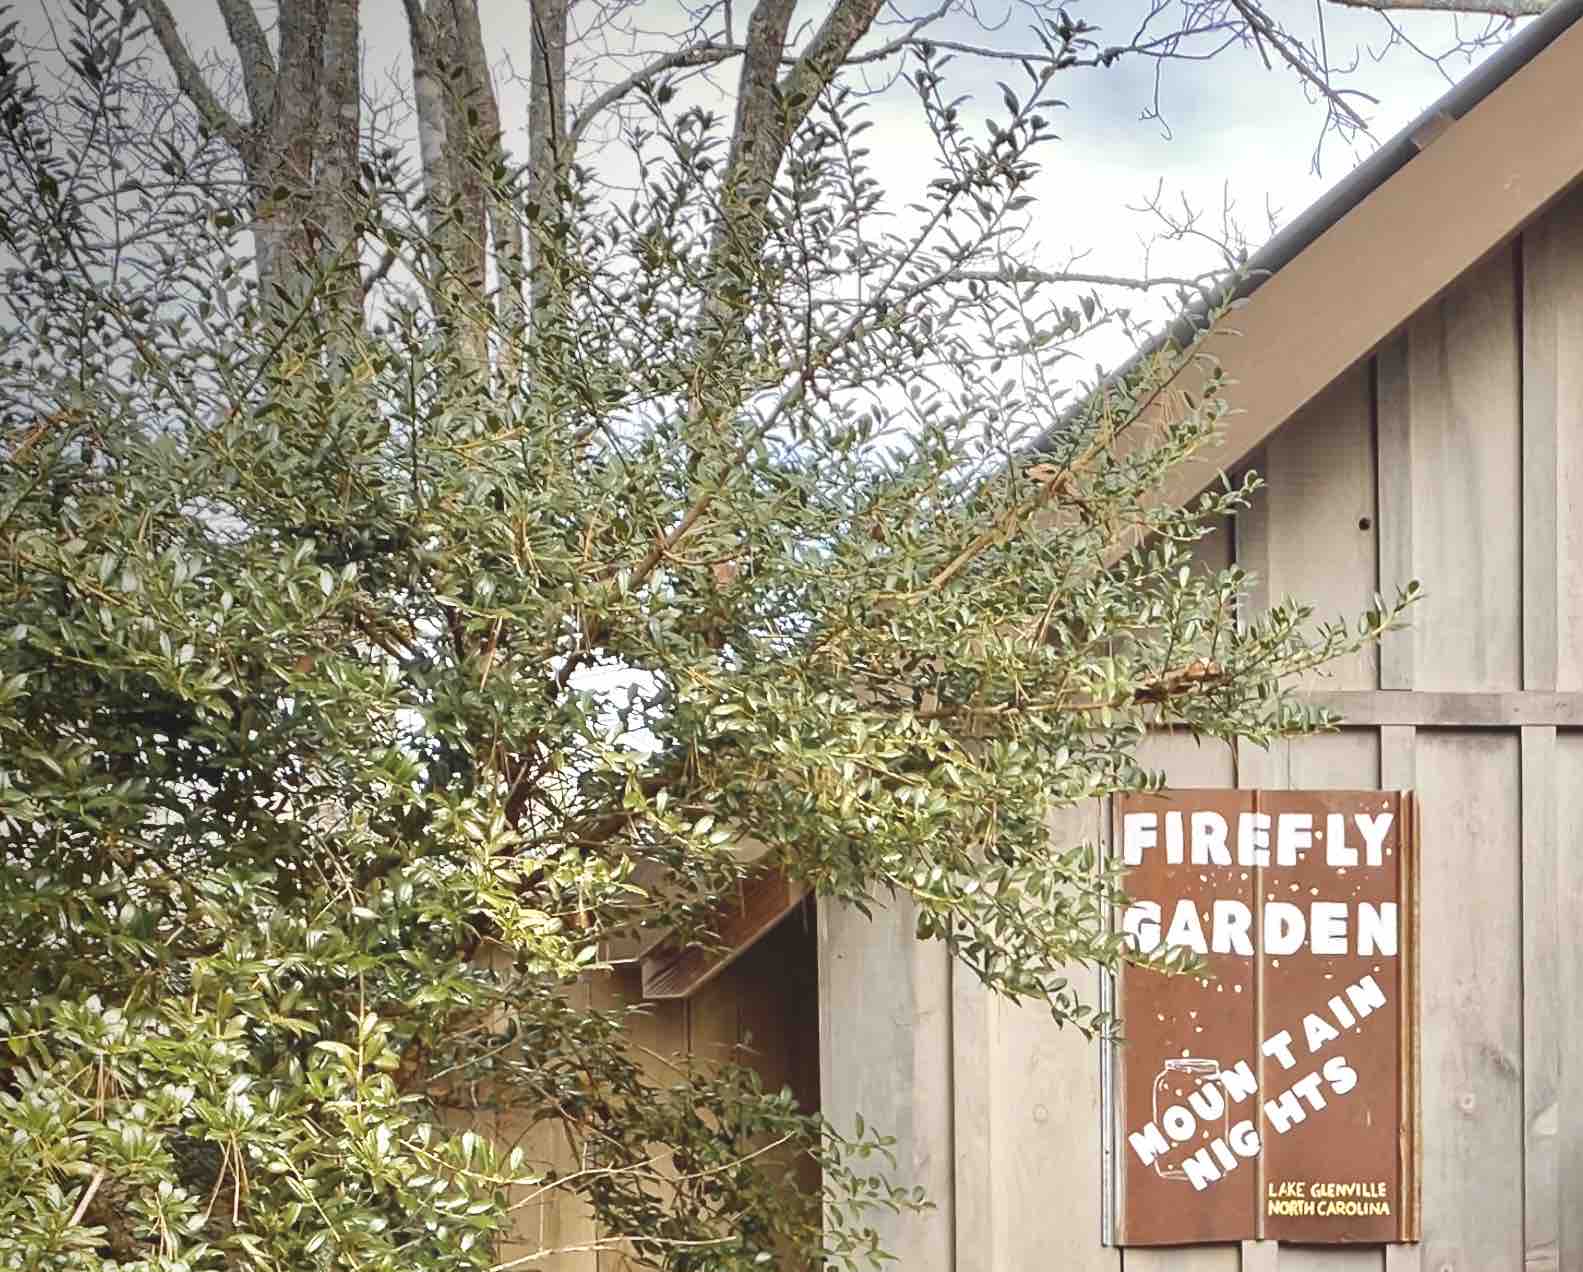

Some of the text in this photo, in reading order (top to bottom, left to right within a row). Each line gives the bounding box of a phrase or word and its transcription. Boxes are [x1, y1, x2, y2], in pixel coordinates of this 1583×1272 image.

[1123, 811, 1394, 866] FIREFLY
[1123, 900, 1398, 956] GARDEN
[1182, 1055, 1358, 1192] NIGHTS
[1268, 1181, 1387, 1198] LAKE GLENVILLE
[1268, 1200, 1390, 1216] NORTH CAROLINA
